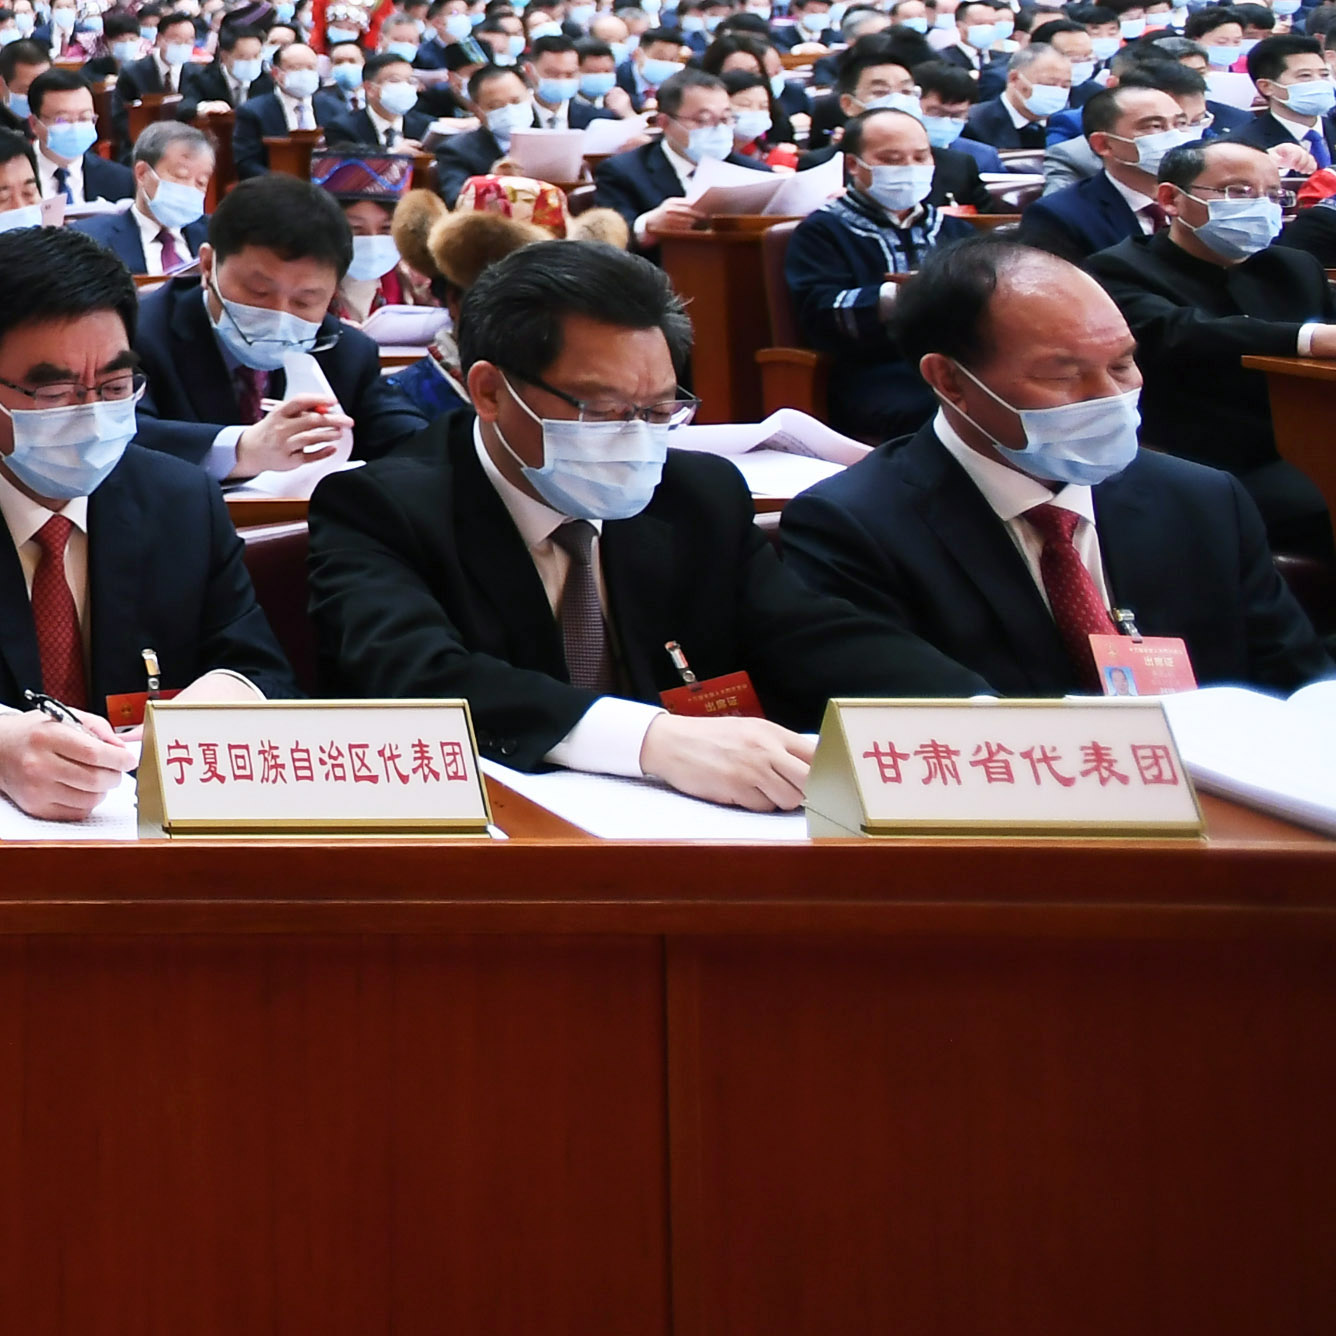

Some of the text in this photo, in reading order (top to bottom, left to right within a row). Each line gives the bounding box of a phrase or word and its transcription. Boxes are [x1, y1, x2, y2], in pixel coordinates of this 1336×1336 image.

[166, 738, 469, 786] 宁夏回族自治区代表团
[862, 740, 1180, 788] 甘肃省代表团
